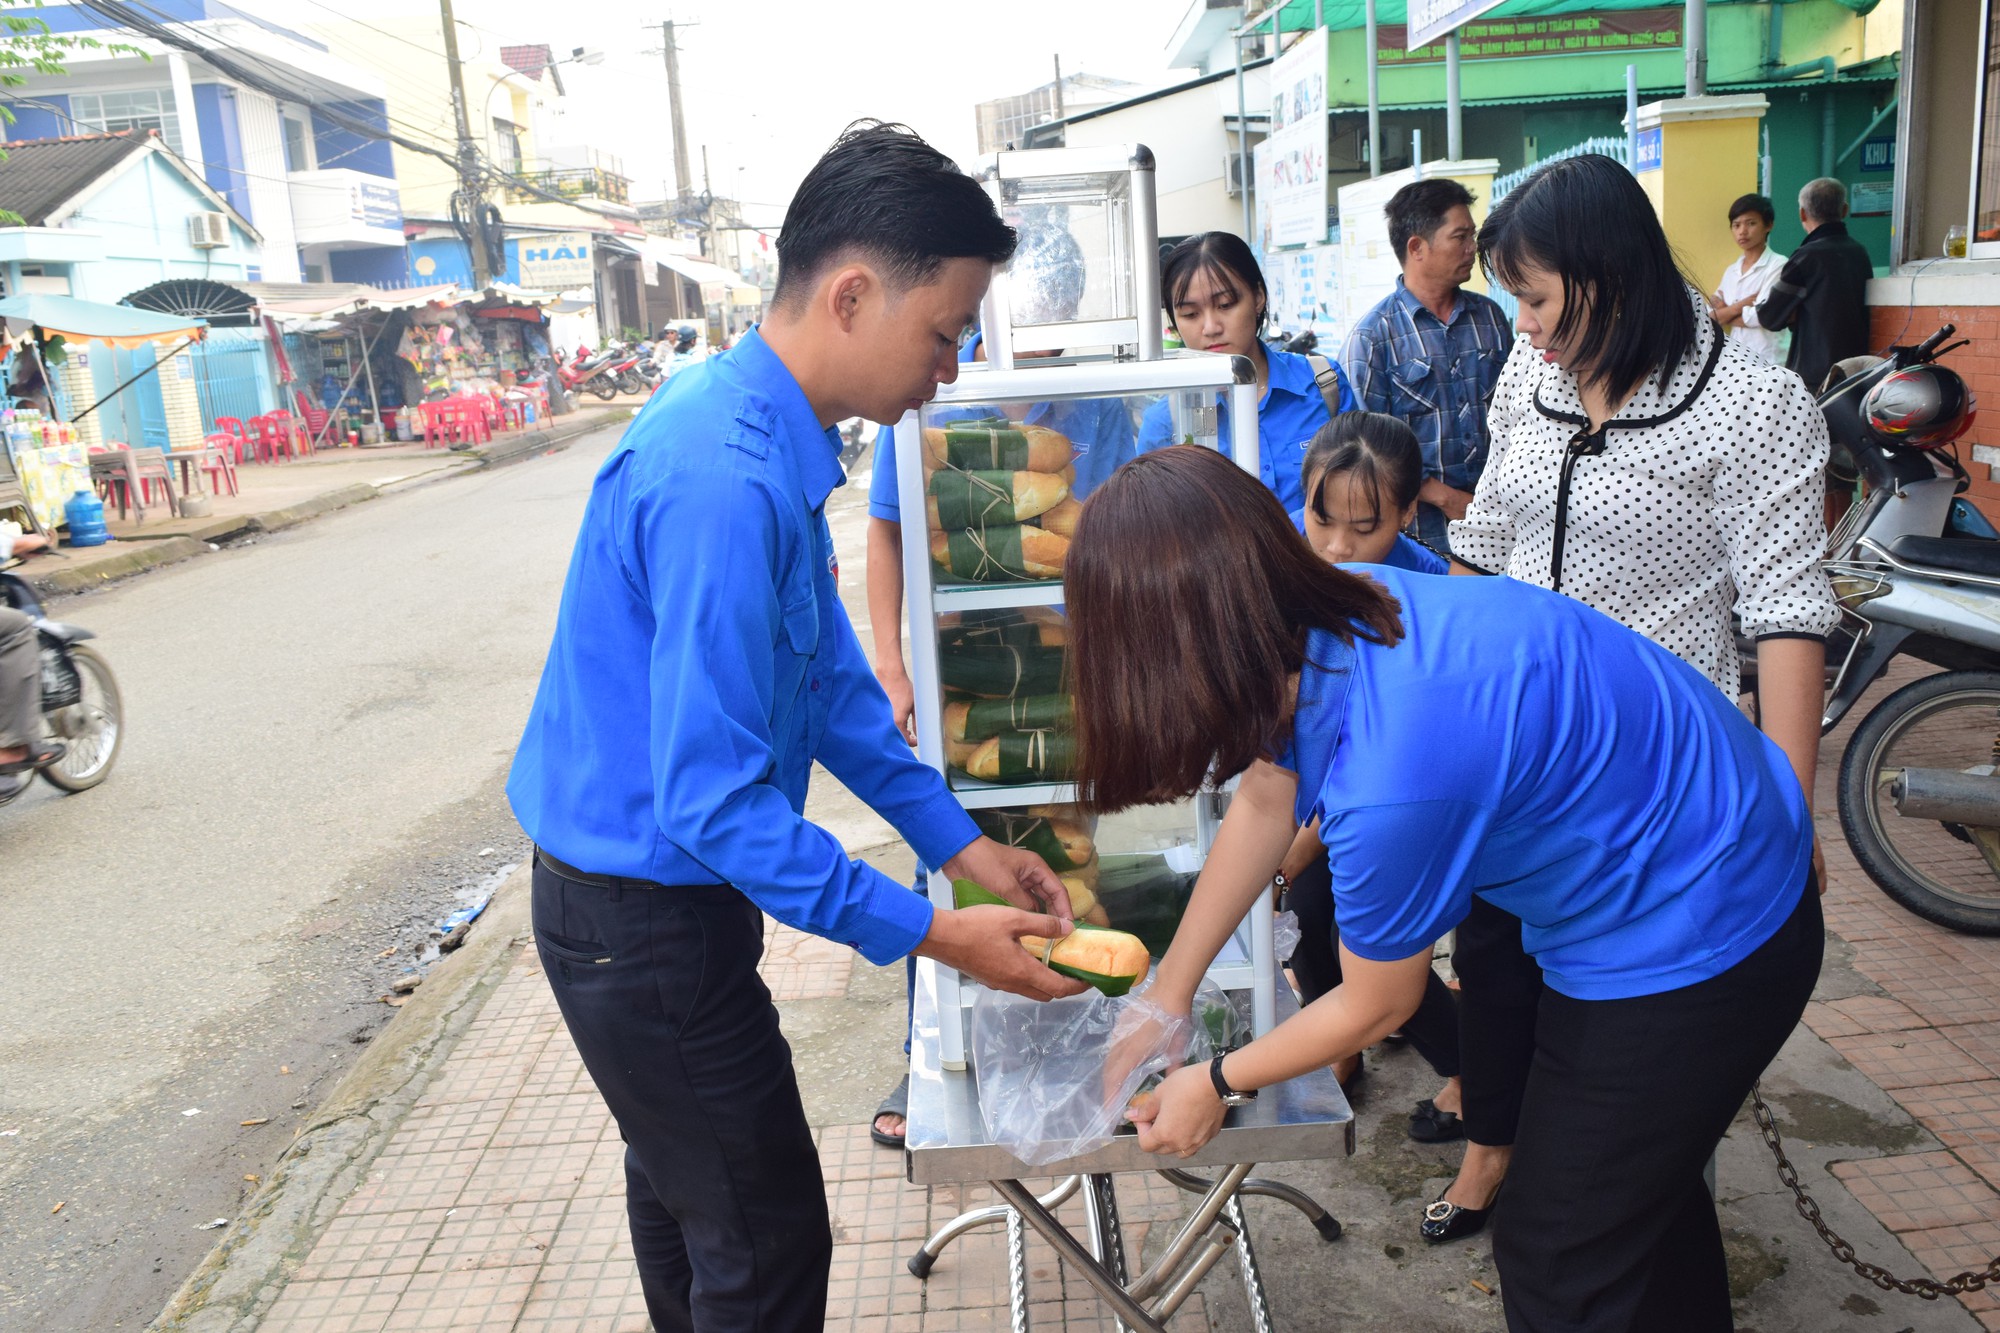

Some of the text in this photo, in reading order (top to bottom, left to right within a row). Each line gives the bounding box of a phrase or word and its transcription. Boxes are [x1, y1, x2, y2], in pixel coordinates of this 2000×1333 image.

[1489, 22, 1515, 36] KHÁNG
[1517, 22, 1535, 34] SINH
[1549, 18, 1573, 32] TRÁCH
[1587, 35, 1601, 47] MAI
[1602, 32, 1629, 46] KHÔNG
[1865, 143, 1887, 165] KHU
